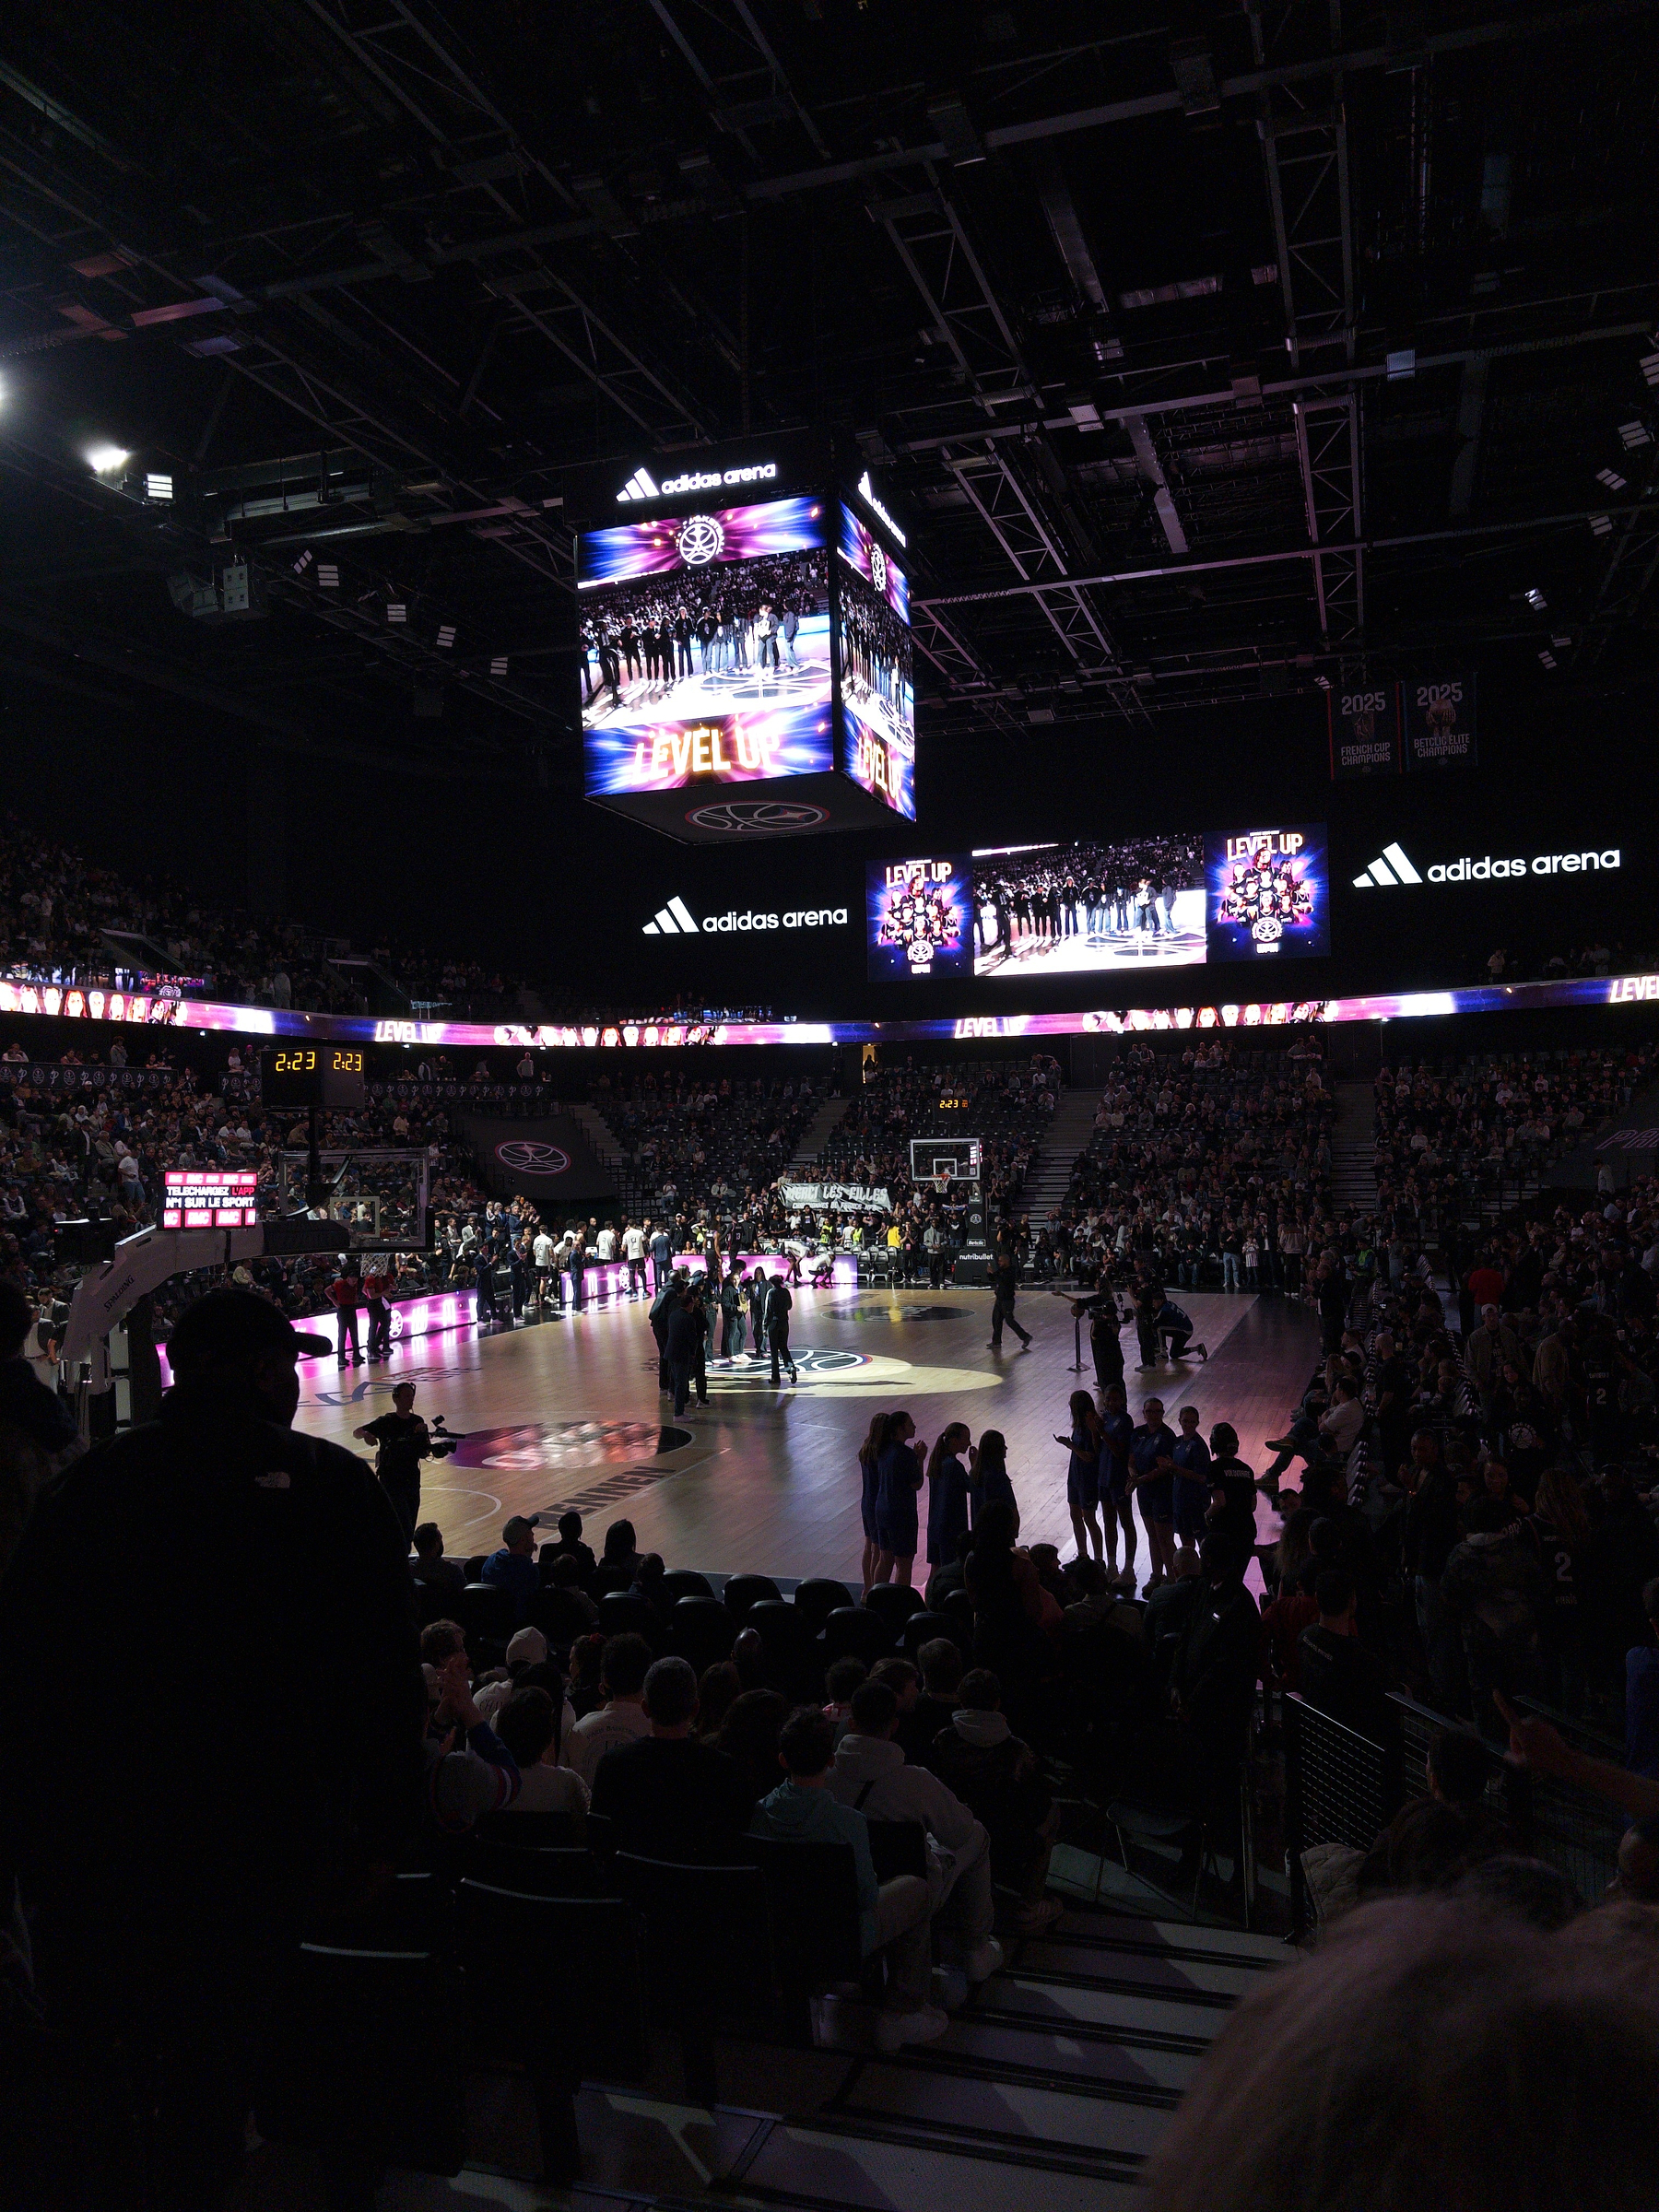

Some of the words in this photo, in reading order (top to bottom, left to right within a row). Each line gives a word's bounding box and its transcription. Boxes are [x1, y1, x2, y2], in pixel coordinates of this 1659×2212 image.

[662, 473, 722, 494] adidas
[724, 464, 776, 485] arena
[1341, 691, 1386, 715] 2025
[1417, 682, 1463, 707] 2025
[1341, 745, 1372, 757] FRENCH
[1374, 741, 1391, 754] CUP
[1414, 735, 1447, 749] BETCLIC
[1418, 743, 1467, 759] CHAMPIONS
[630, 728, 732, 785] LEVEL
[735, 726, 782, 771] UP
[857, 736, 888, 792] LEVEL
[1342, 751, 1391, 766] CHAMPIONS
[1227, 835, 1277, 862] LEVEL
[1279, 833, 1303, 855] UP
[886, 864, 930, 888] LEVEL
[931, 863, 952, 883] UP
[1427, 856, 1527, 883] adidas
[1531, 849, 1620, 876] arena
[702, 911, 779, 933] adidas
[782, 908, 848, 928] arena
[1609, 976, 1659, 1004] LEVE
[375, 1021, 421, 1043] LEVEL
[955, 1018, 1003, 1039] LEVEL
[276, 1051, 316, 1072] 2:23
[333, 1052, 362, 1072] 2:23
[939, 1100, 959, 1109] 2:23
[184, 1196, 206, 1208] SUR
[207, 1196, 221, 1208] LE
[222, 1196, 255, 1207] SPORT
[231, 1186, 255, 1196] L'APP
[823, 1185, 843, 1199] LES
[104, 1275, 135, 1312] SPALDING
[1595, 1387, 1606, 1405] 2
[1554, 1551, 1573, 1583] 2
